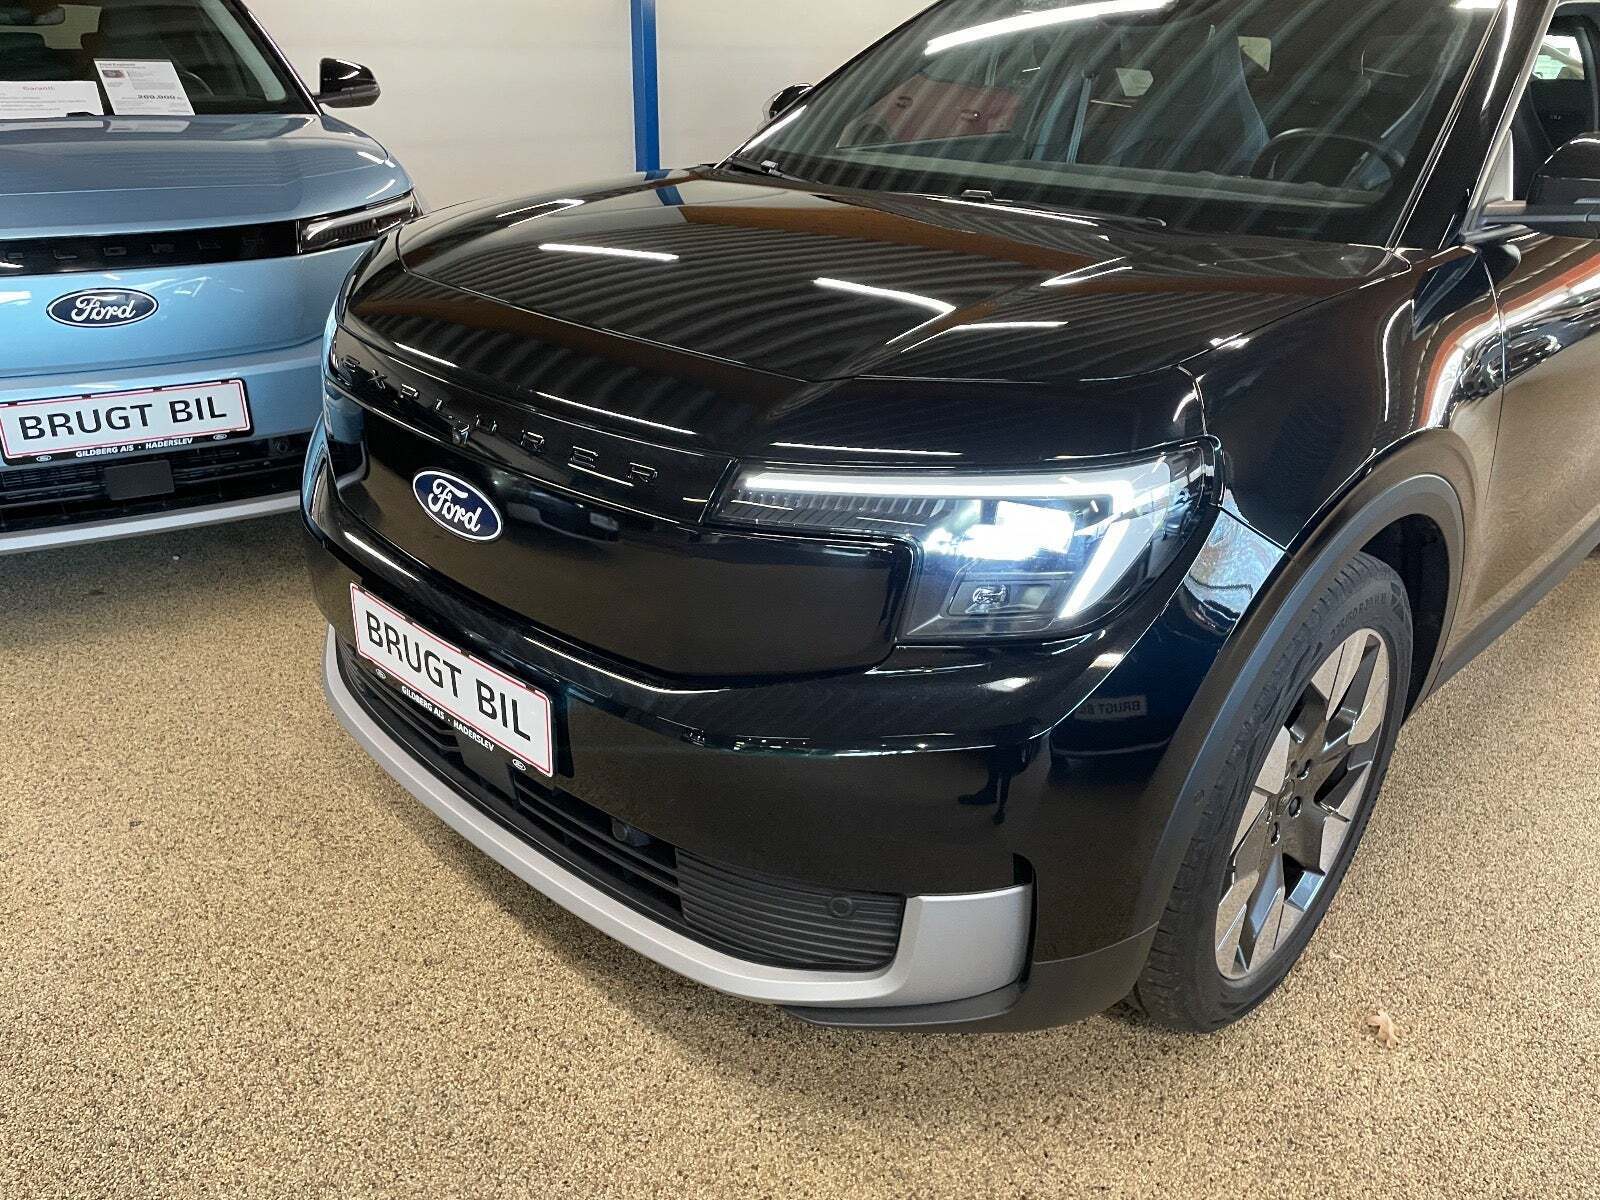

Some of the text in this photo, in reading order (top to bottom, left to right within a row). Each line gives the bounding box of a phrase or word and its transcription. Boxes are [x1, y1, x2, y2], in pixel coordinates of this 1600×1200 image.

[70, 295, 136, 322] Ford
[18, 396, 228, 441] BRUGT BIL
[75, 445, 118, 458] GILDBERG
[145, 437, 194, 450] HADERSLEV
[427, 478, 481, 533] Ford
[365, 609, 532, 743] BRUGT BIL
[401, 685, 433, 712] GILDBERG
[453, 719, 495, 752] HADERSLEV
